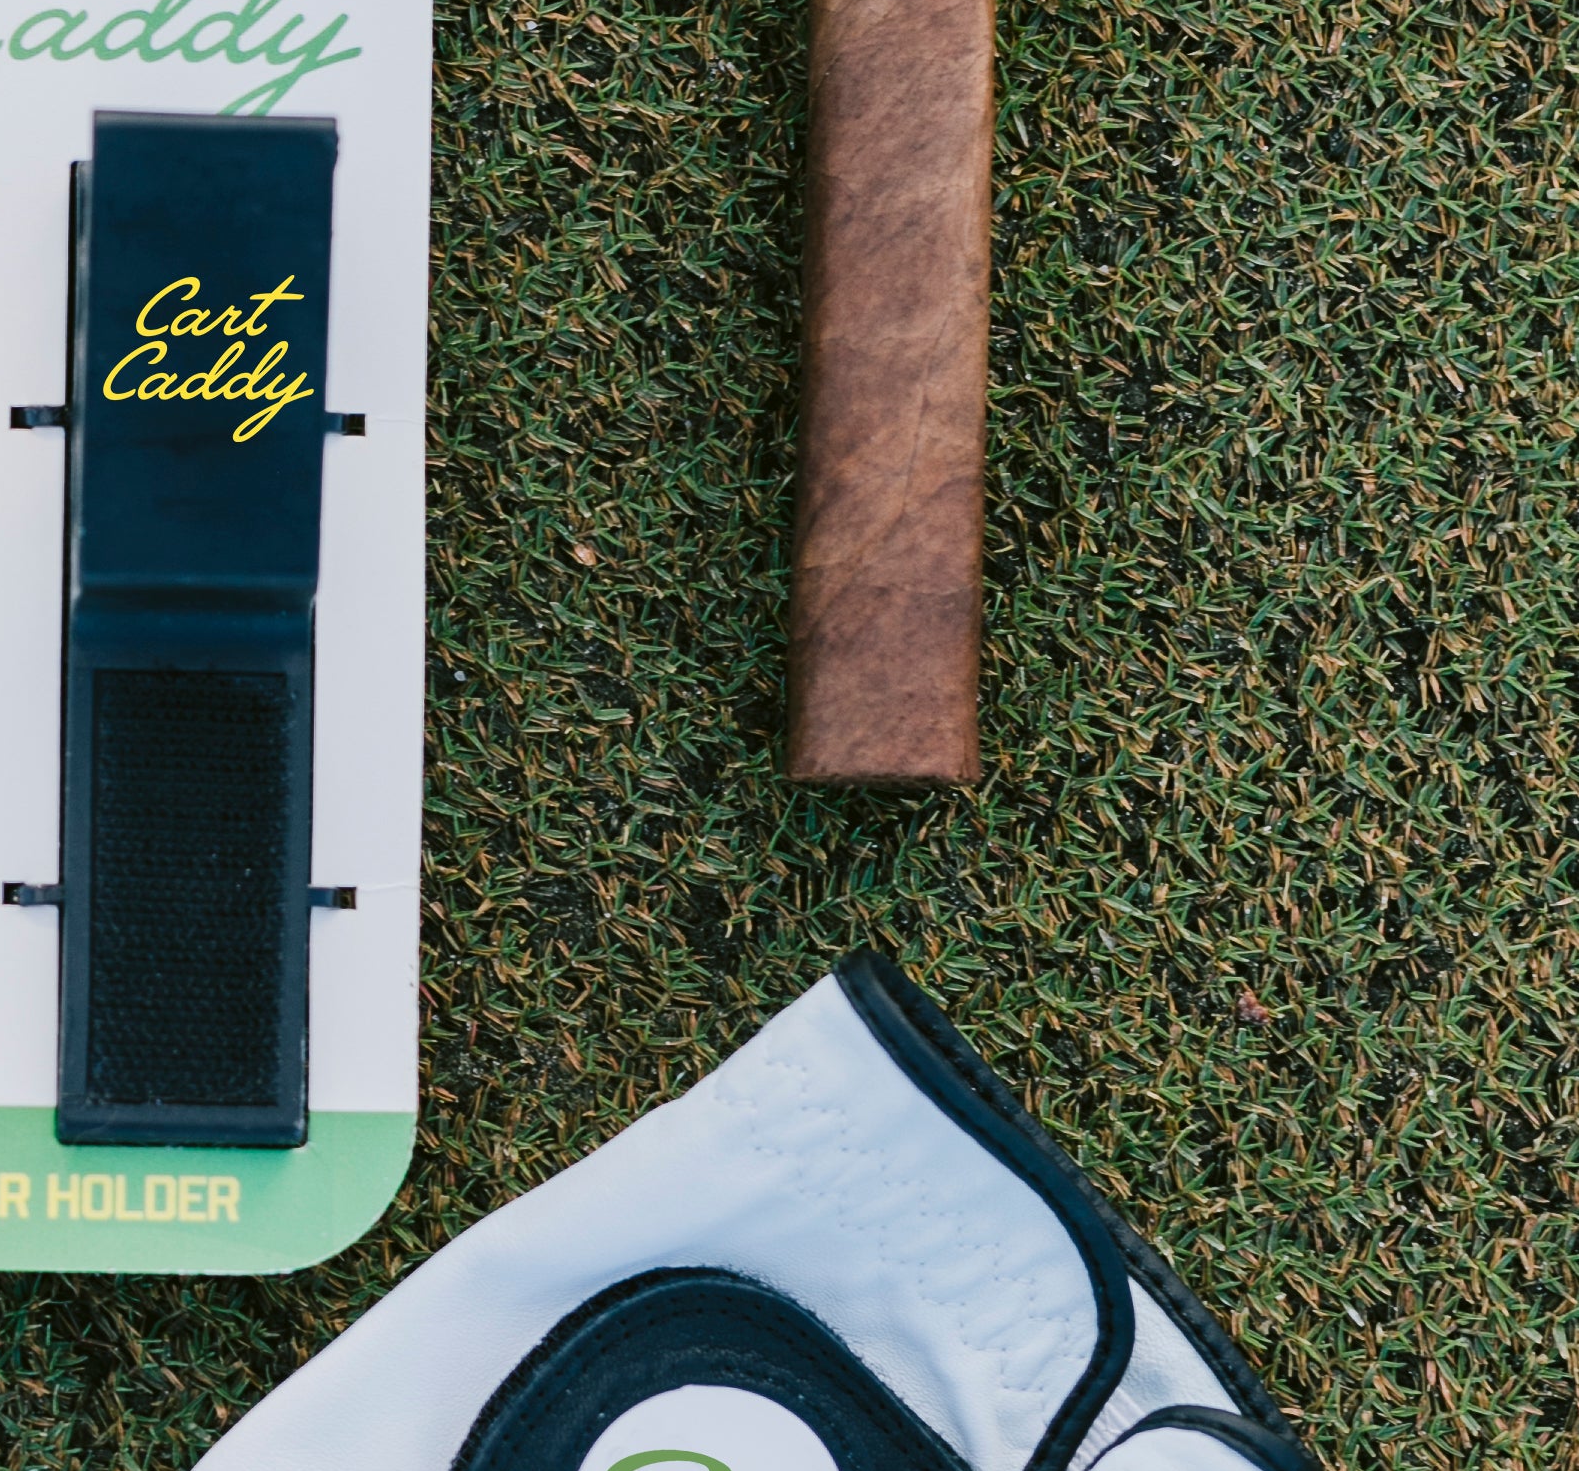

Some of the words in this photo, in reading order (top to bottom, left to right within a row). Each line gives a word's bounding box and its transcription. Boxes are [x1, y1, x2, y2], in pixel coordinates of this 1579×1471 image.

[135, 274, 305, 337] Cart
[102, 340, 315, 443] Caddy
[46, 1174, 240, 1222] HOLDER
